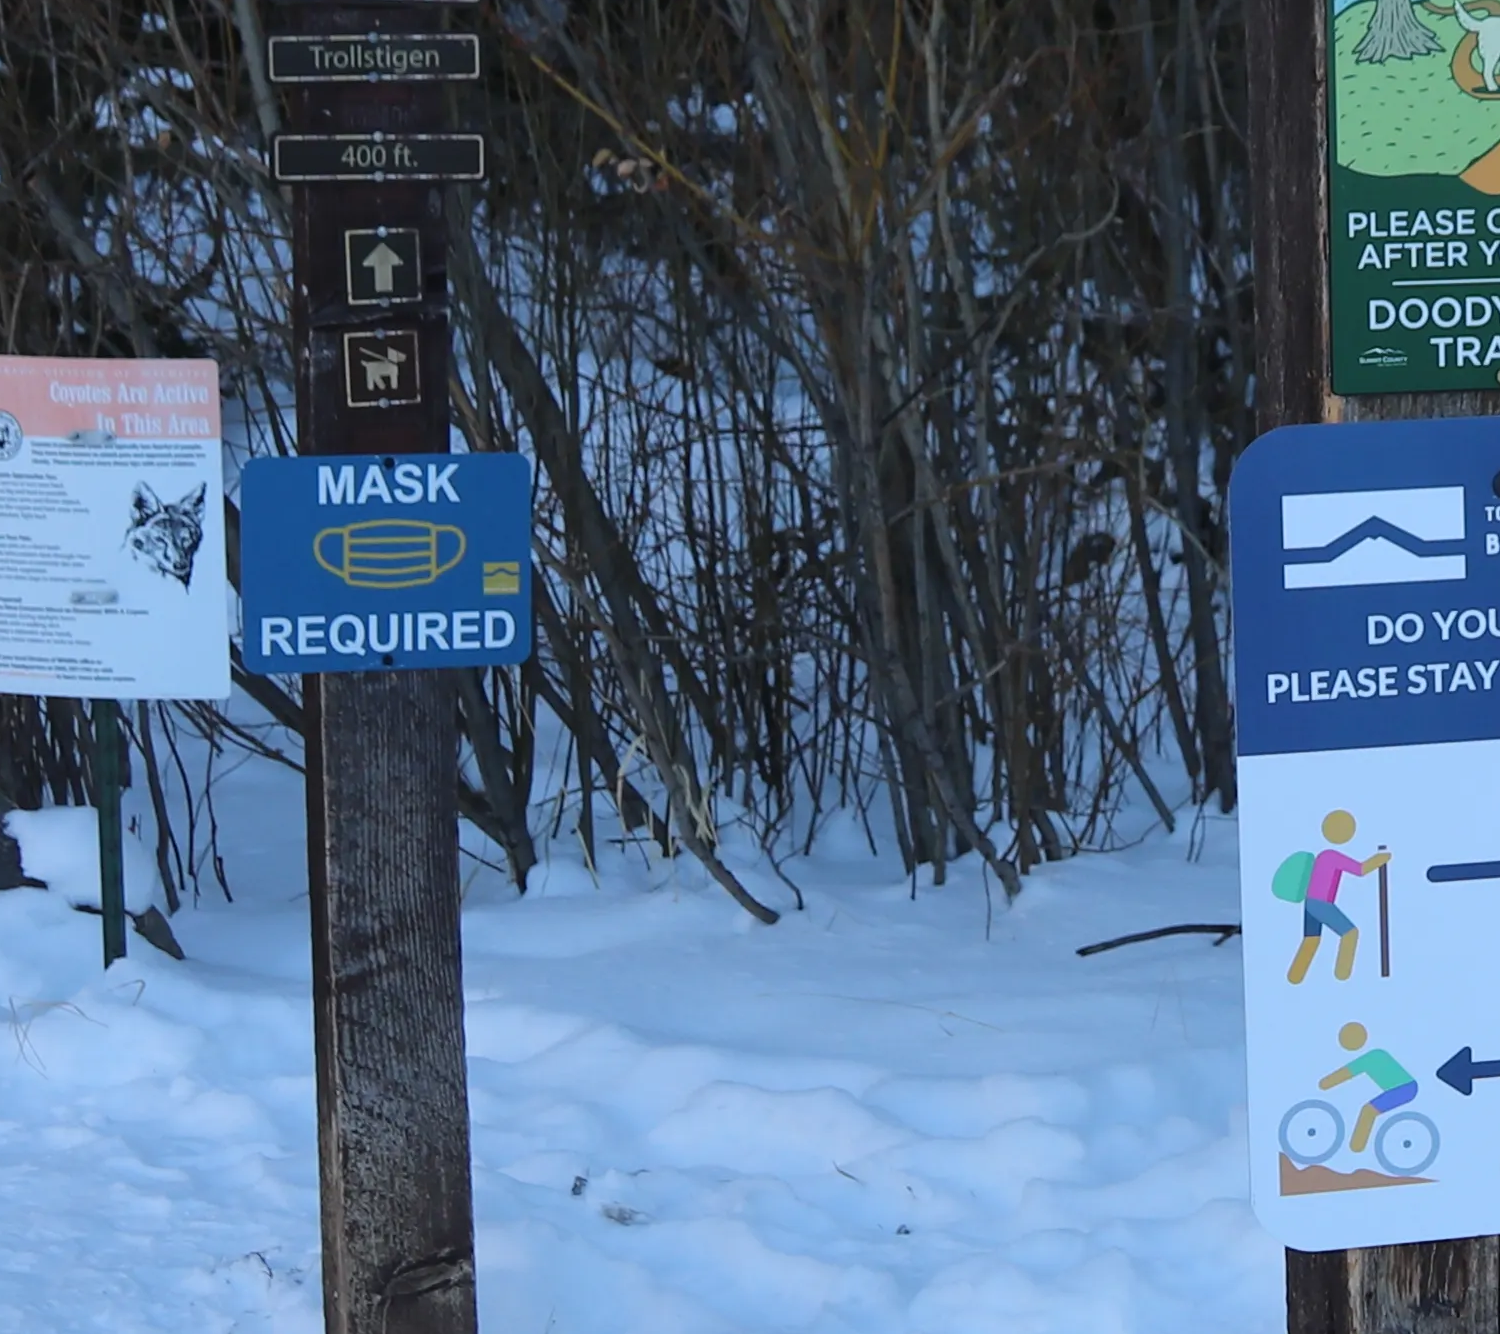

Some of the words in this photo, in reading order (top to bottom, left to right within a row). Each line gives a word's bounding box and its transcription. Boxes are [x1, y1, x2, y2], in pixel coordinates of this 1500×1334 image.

[308, 45, 440, 71] Trollstigen
[341, 146, 386, 166] 400
[393, 145, 418, 166] ft.
[1348, 209, 1475, 238] PLEASE
[1358, 240, 1468, 269] AFTER
[50, 382, 112, 407] Coyotes
[118, 383, 148, 404] Are
[155, 383, 210, 405] Active
[97, 413, 116, 432] In
[121, 413, 162, 434] This
[168, 414, 211, 436] Area
[316, 463, 461, 505] MASK
[260, 610, 516, 656] REQUIRED
[1366, 612, 1423, 645] DO
[1267, 666, 1398, 704] PLEASE
[1407, 660, 1500, 696] STAY
